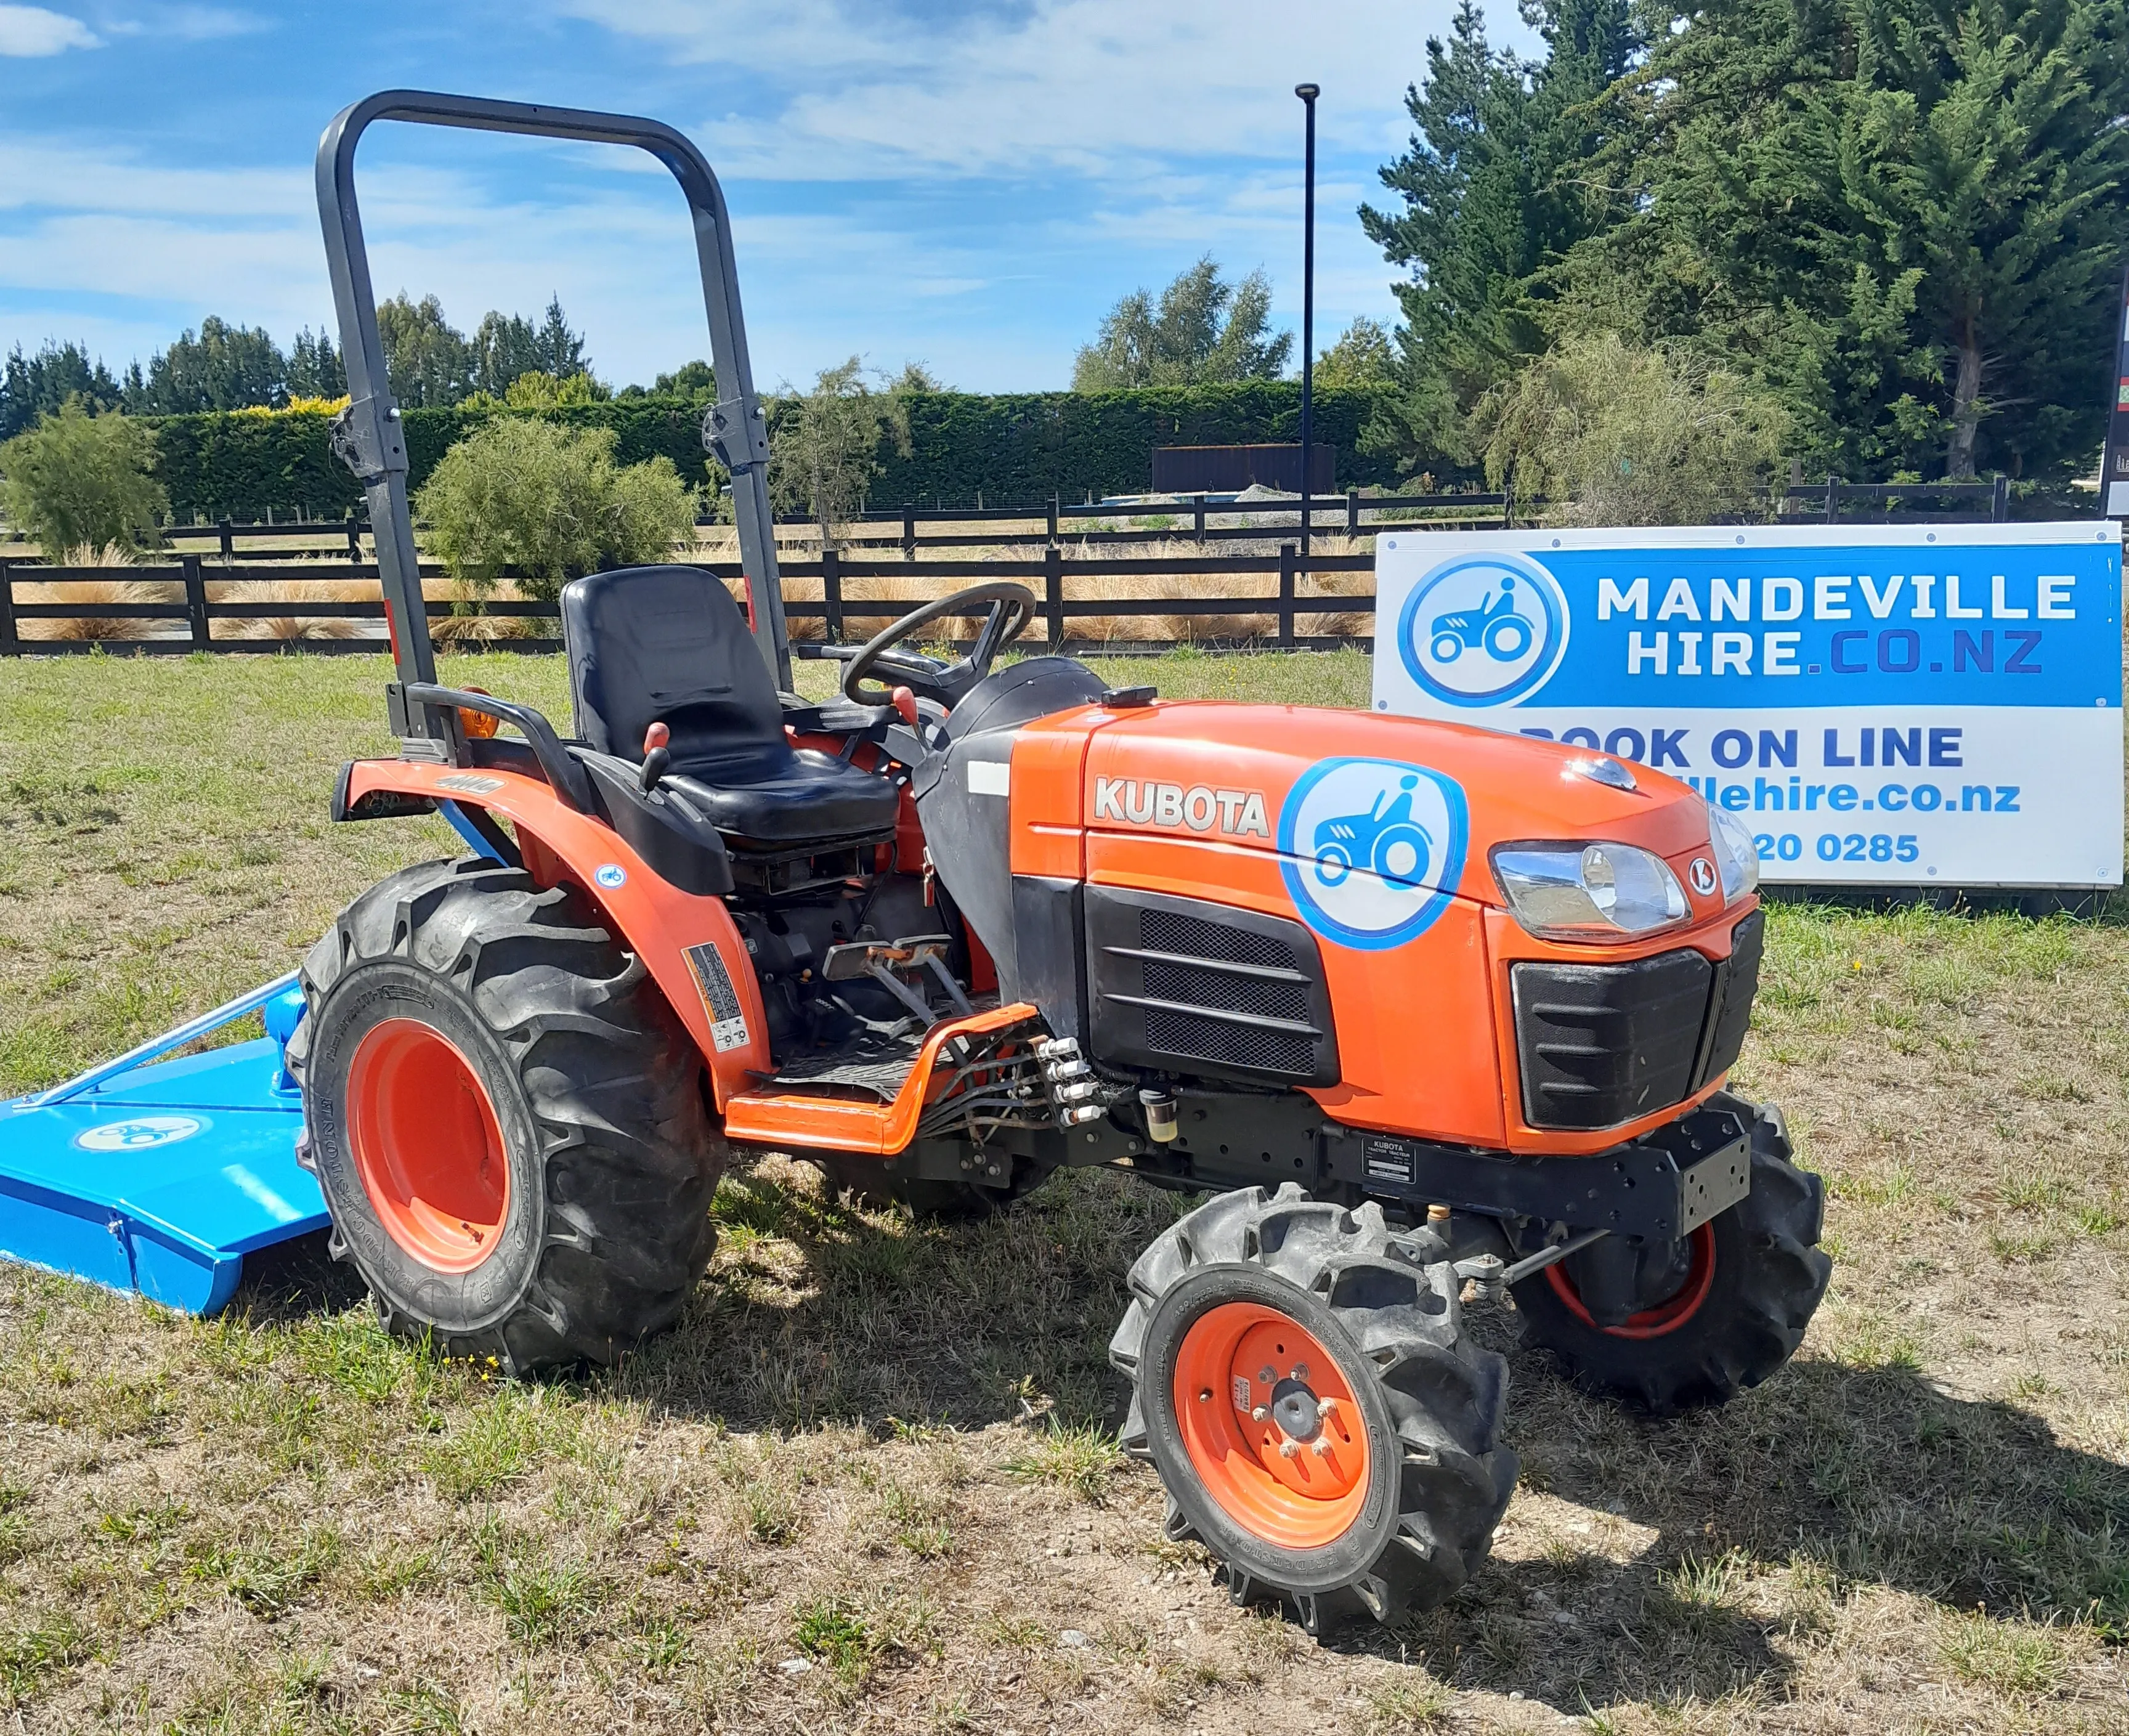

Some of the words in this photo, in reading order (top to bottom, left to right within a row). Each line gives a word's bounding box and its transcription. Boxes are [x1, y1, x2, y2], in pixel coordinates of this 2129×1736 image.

[1597, 575, 2077, 621] MANDEVILLE
[1627, 629, 2043, 676] HIRE.CO.NZ
[1519, 727, 1692, 768] OK
[1710, 728, 1798, 769] ON
[1823, 727, 1964, 768] LINE
[1095, 777, 1270, 838] KUBOTA
[1673, 776, 2021, 812] lehire.co.nz
[1817, 834, 1920, 862] 0285
[1374, 1140, 1403, 1151] KUBOTA
